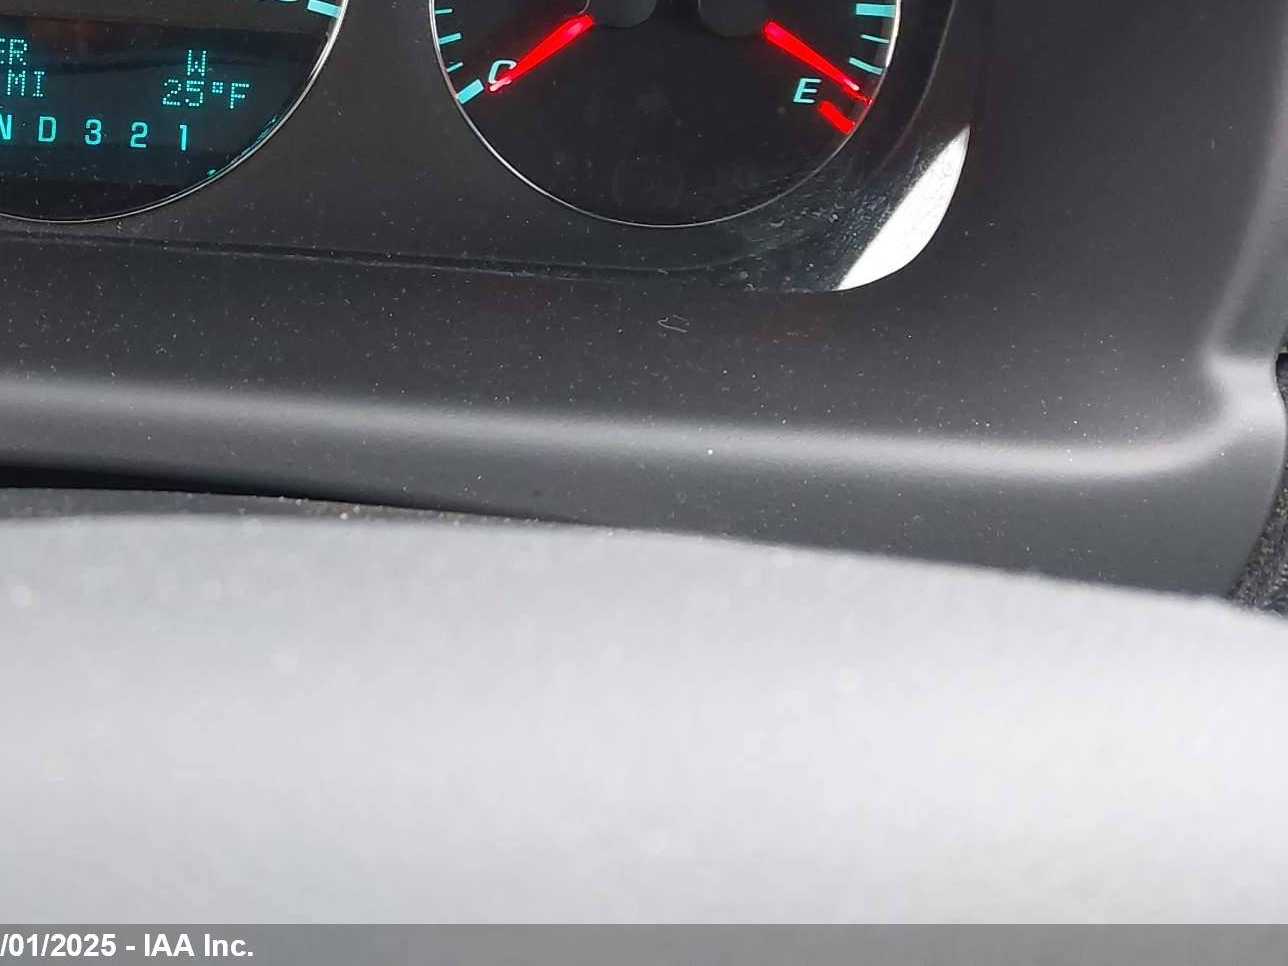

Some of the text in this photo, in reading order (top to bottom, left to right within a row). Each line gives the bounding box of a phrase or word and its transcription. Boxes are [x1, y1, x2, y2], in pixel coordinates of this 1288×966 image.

[186, 49, 208, 77] W
[487, 59, 517, 86] C
[6, 70, 45, 98] MI
[792, 77, 822, 104] E
[37, 115, 58, 143] D
[84, 118, 103, 146] 3
[129, 121, 149, 149] 2
[179, 124, 189, 151] 1
